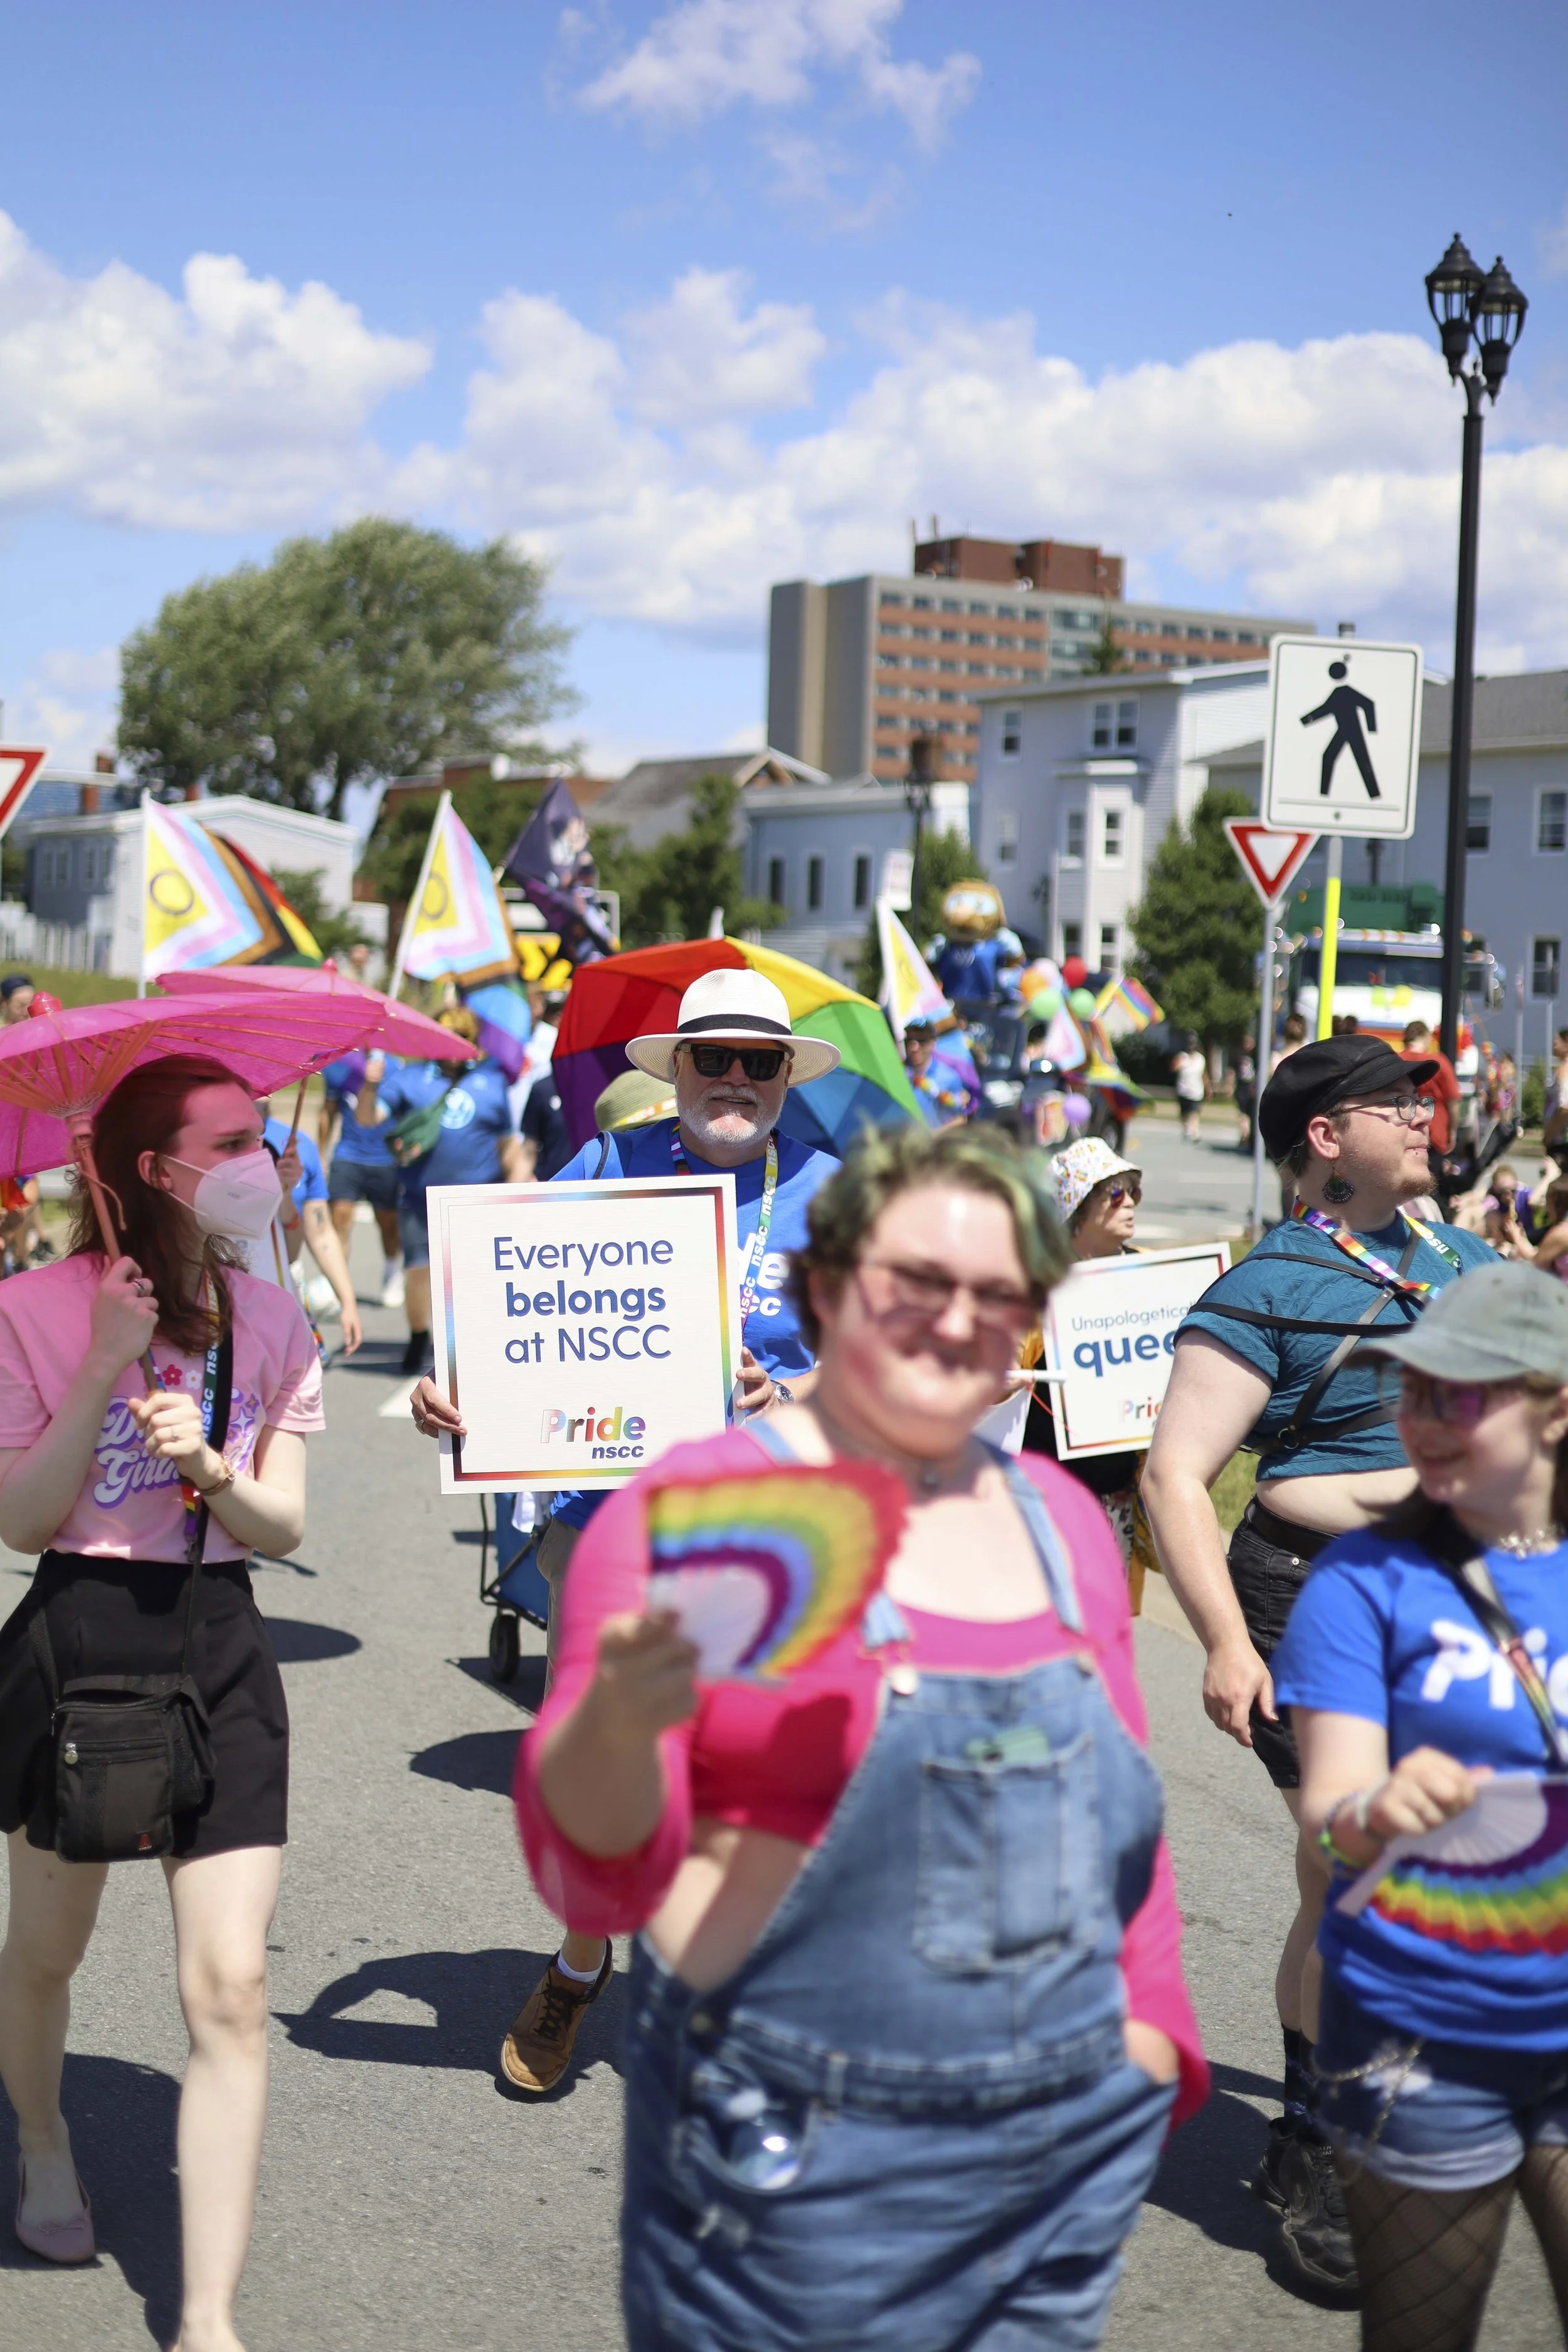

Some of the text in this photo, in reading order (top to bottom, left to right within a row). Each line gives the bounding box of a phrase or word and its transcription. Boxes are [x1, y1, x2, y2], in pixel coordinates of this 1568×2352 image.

[761, 1175, 775, 1216] nscc
[494, 1236, 674, 1276] Everyone
[751, 1225, 768, 1267] nscc
[506, 1280, 666, 1322] belongs
[741, 1276, 756, 1319] nscc
[1071, 1299, 1196, 1332] Unapologetica
[505, 1325, 672, 1364] at NSCC
[540, 1406, 646, 1443] Pride
[591, 1445, 644, 1459] nscc
